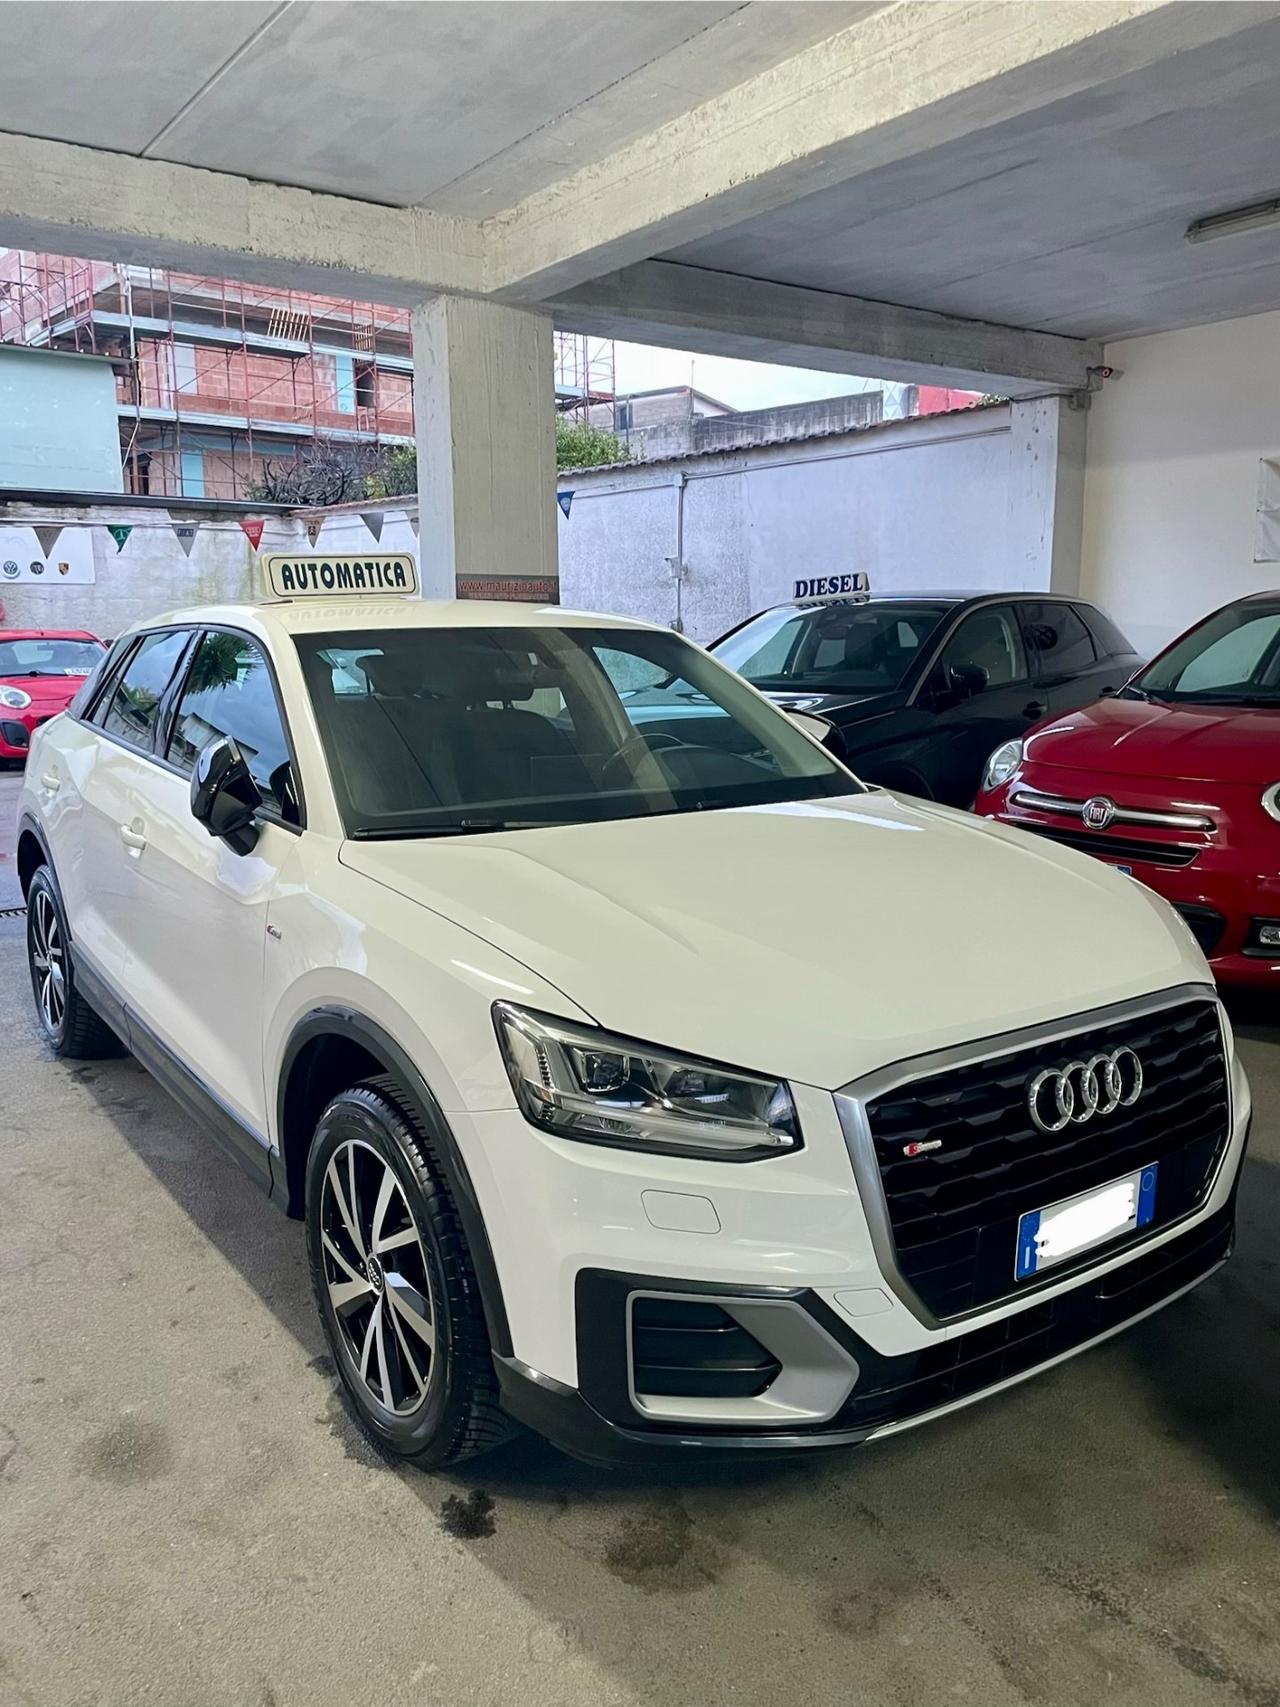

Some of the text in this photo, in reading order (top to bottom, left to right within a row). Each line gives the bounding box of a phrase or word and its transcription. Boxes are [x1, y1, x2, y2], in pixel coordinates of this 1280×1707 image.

[281, 562, 406, 590] AUTOMATICA
[794, 574, 864, 598] DIESEL
[1089, 806, 1106, 820] FIAT
